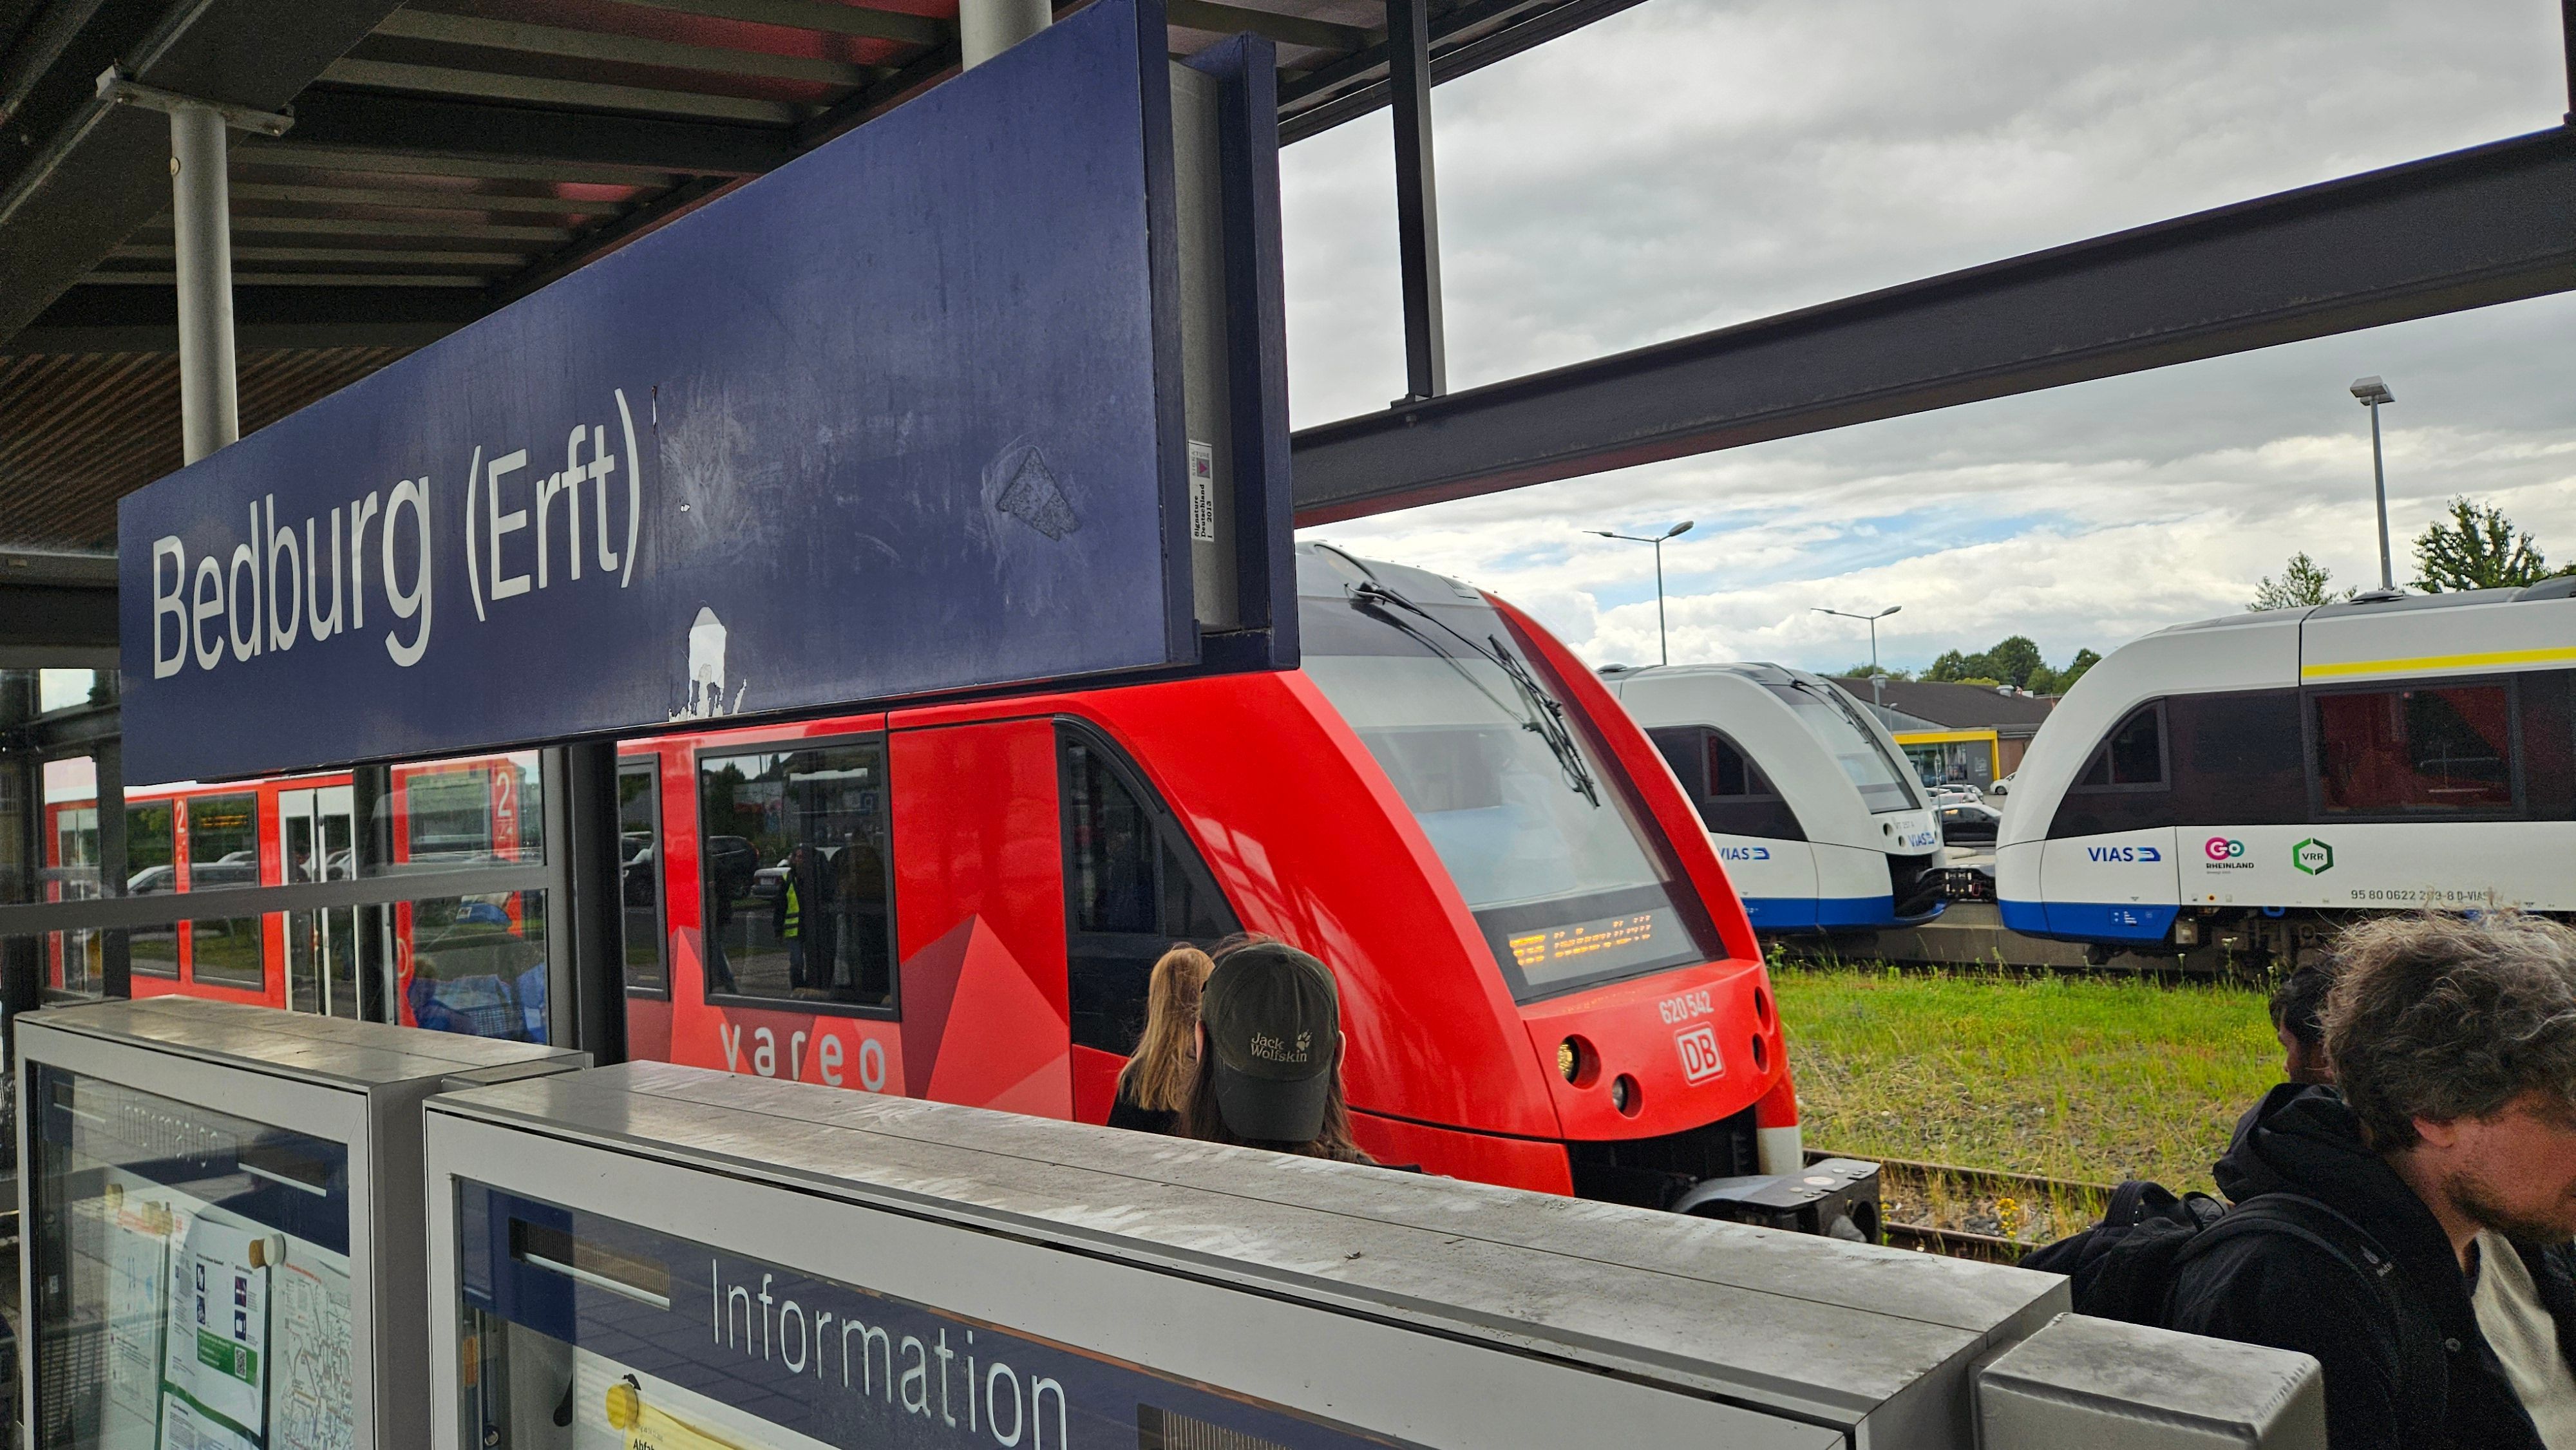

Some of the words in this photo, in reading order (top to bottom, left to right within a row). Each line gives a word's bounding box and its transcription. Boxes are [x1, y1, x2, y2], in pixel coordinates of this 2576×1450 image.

[153, 476, 431, 679] Bedburg
[466, 388, 640, 622] (Erft)
[496, 772, 512, 817] 2
[176, 800, 185, 833] 2
[1908, 833, 1926, 847] VIAS
[2087, 847, 2134, 862] VIAS
[2351, 890, 2365, 899] 95
[2369, 890, 2383, 899] 80
[2386, 890, 2416, 900] 0622
[1659, 997, 1689, 1024] 620
[1685, 990, 1714, 1017] 542
[1251, 1031, 1284, 1050] Jack
[1251, 1042, 1308, 1062] Wolfskin
[1681, 1033, 1717, 1075] DB
[719, 1024, 886, 1091] vareo
[712, 1258, 1068, 1450] Information
